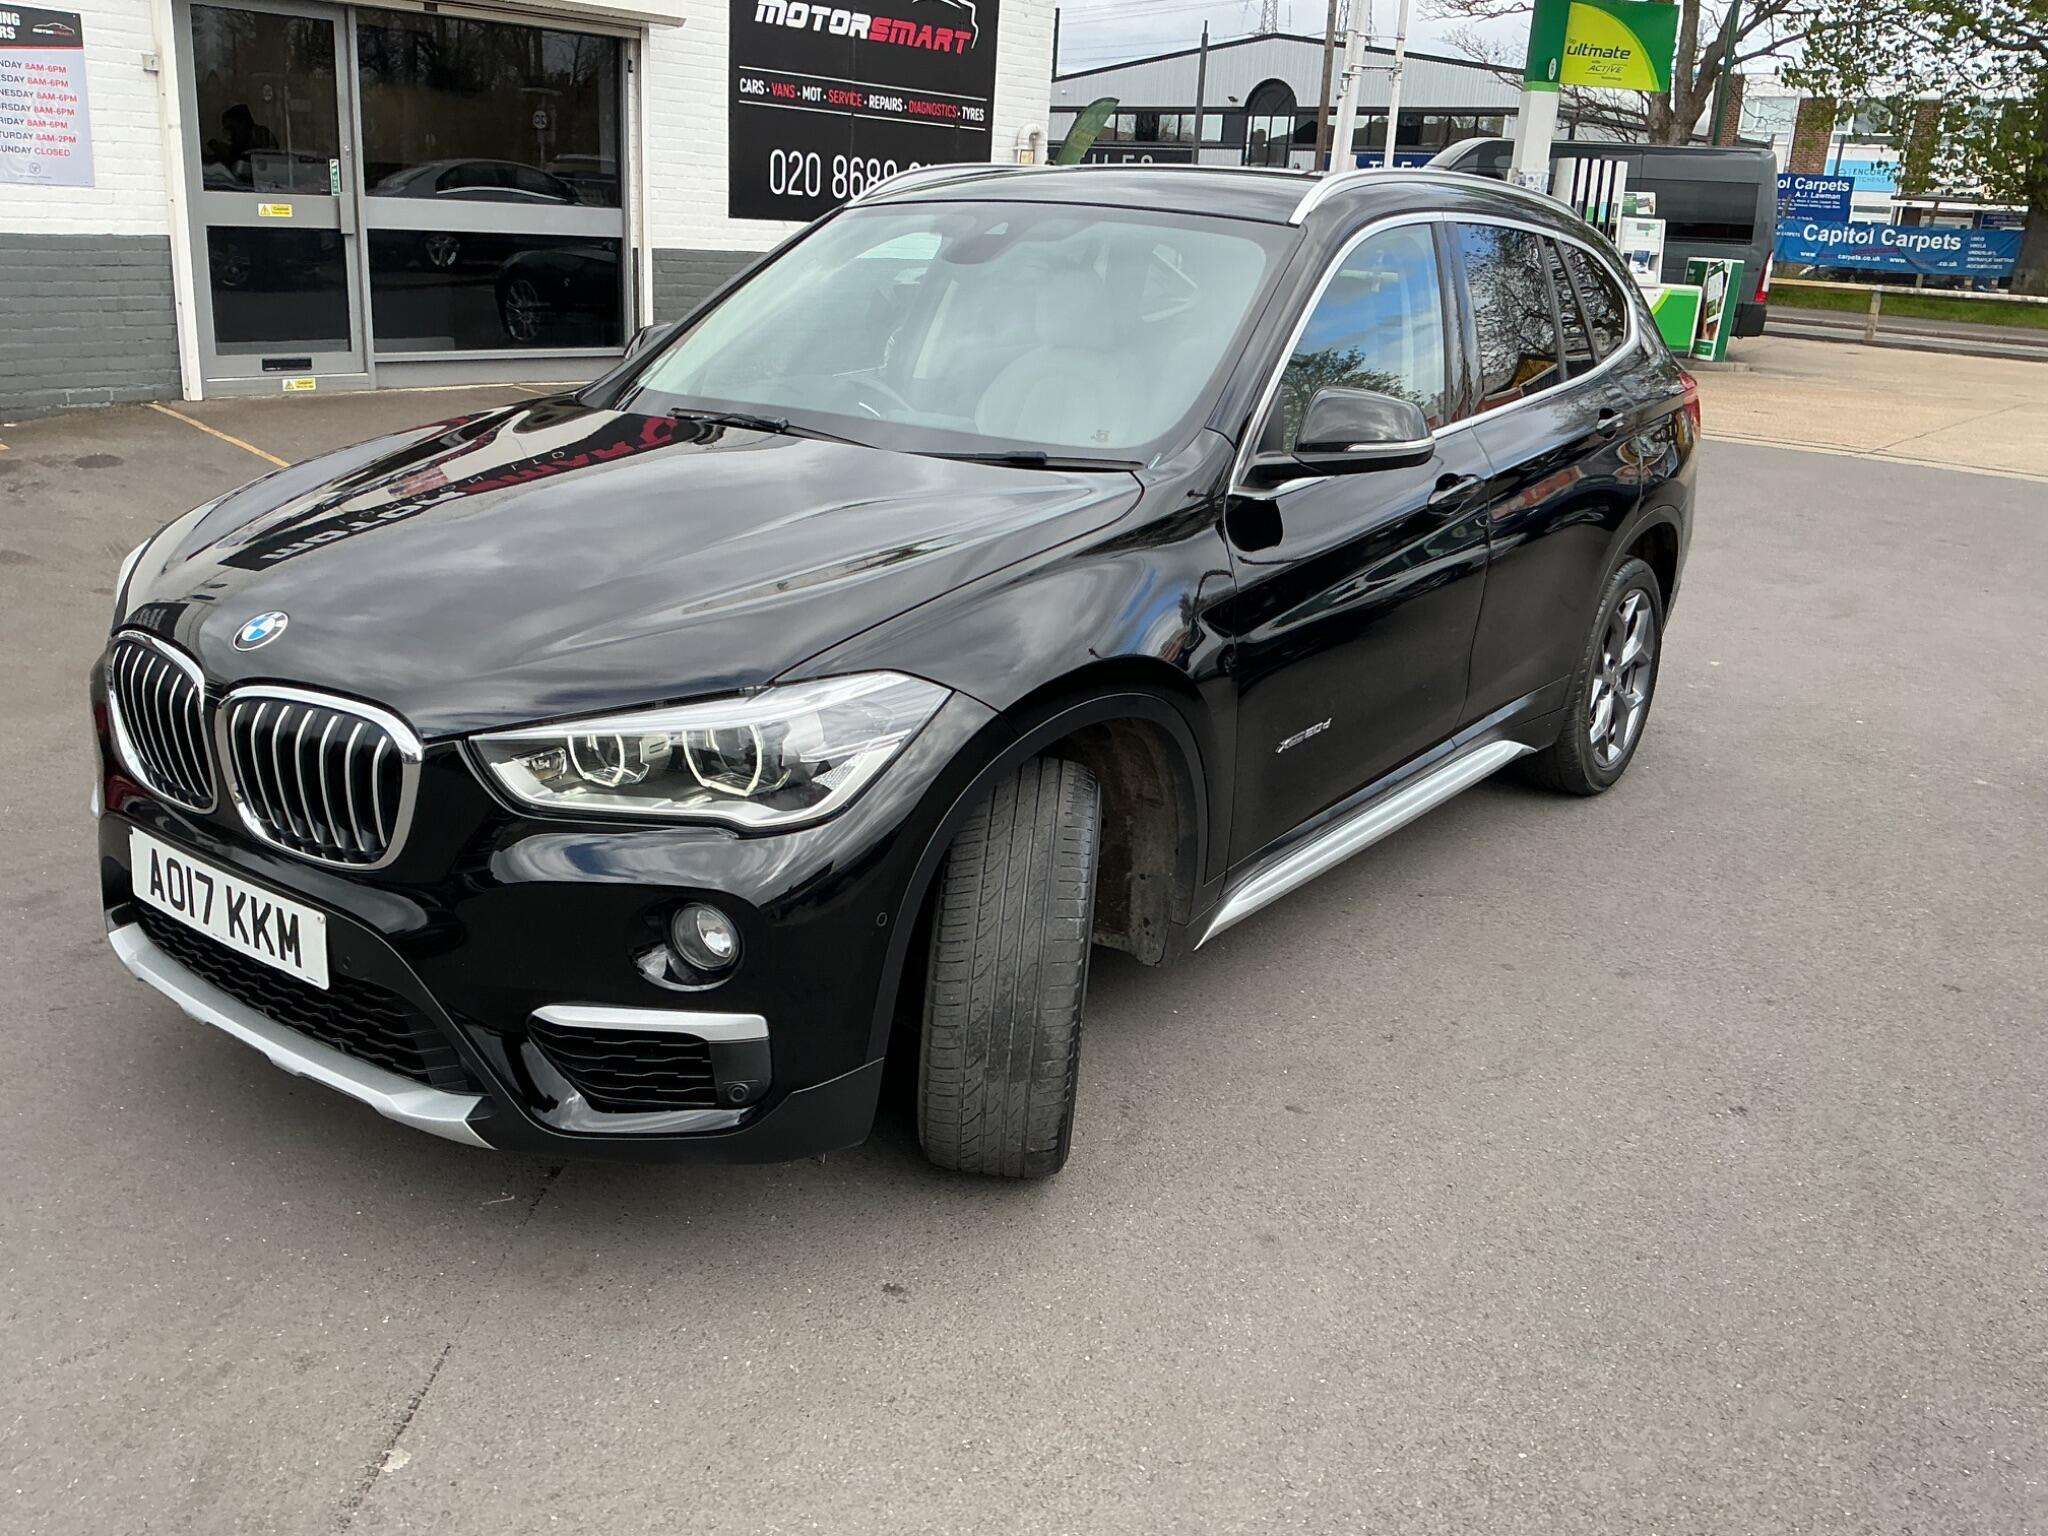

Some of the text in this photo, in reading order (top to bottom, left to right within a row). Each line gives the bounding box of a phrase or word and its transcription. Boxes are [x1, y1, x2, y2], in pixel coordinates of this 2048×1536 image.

[754, 0, 972, 55] MOTORSMART
[1566, 43, 1631, 59] ultimate
[0, 60, 22, 69] NDAY
[1587, 64, 1624, 73] ACTIVE
[0, 74, 25, 83] SDAY
[0, 88, 34, 99] NESDAY
[739, 78, 984, 122] CARS VANS MOT SERVICE REPAIRS DIAGNOSTICS TYRES
[0, 102, 32, 112] RSDAY
[0, 117, 25, 126] RIDAY
[0, 131, 34, 140] TURDAY
[0, 145, 71, 157] UNDAY CLOSED
[769, 149, 822, 197] 020
[1794, 177, 1850, 193] Carpets
[1803, 223, 1875, 246] Capitol
[1881, 228, 1962, 253] Carpets
[150, 847, 303, 969] AO17 KKM
